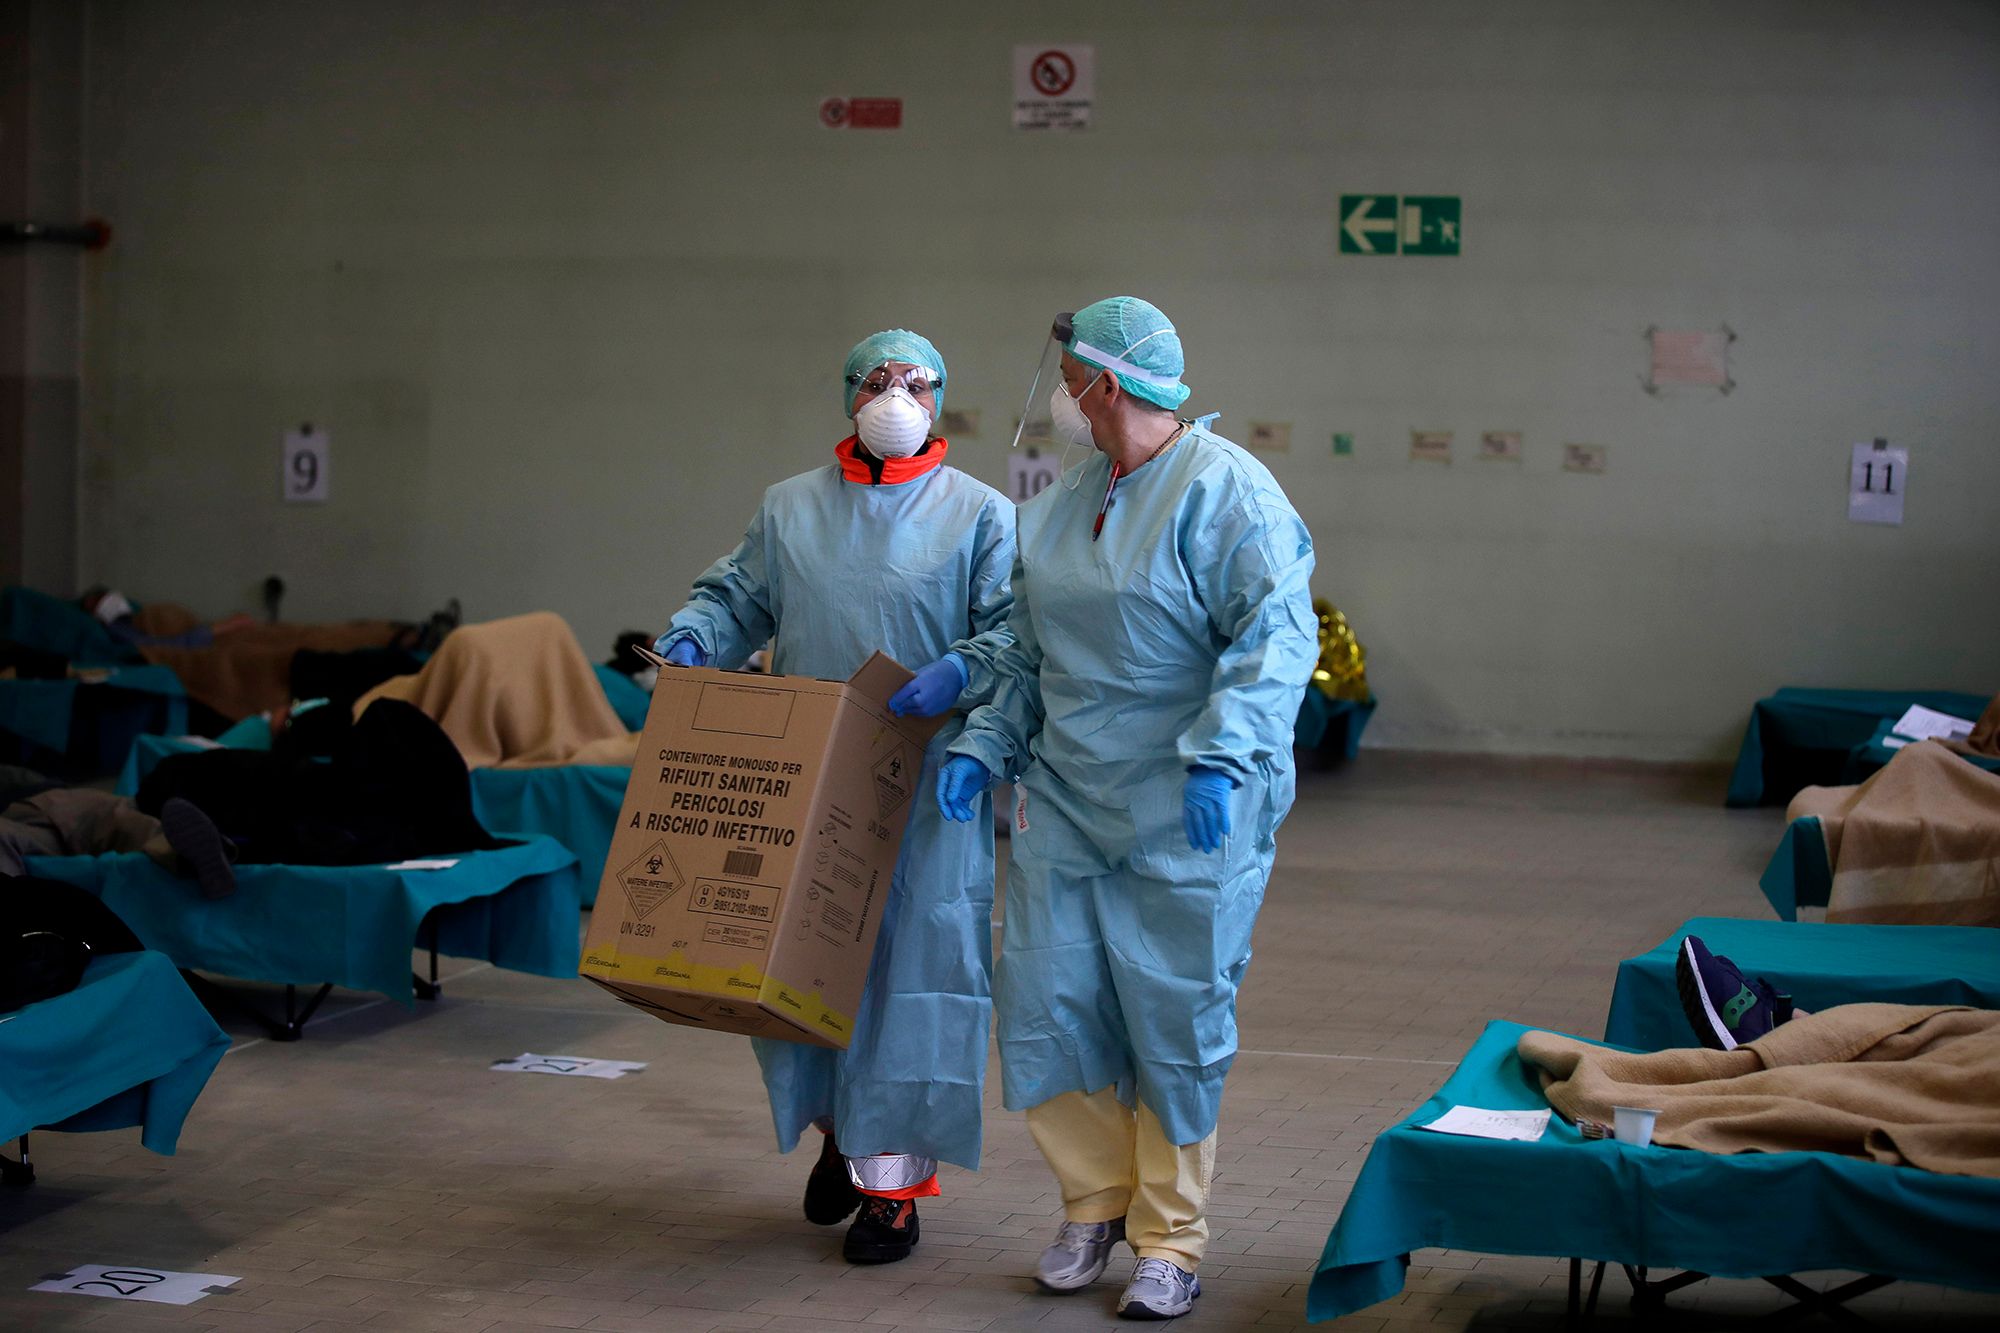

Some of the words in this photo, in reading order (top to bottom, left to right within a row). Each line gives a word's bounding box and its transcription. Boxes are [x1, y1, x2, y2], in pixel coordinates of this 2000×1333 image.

[293, 449, 318, 496] 9
[1017, 469, 1053, 500] 10
[1859, 461, 1896, 495] 11
[658, 749, 727, 767] CONTENITORE
[728, 756, 779, 773] MONOUSO
[781, 762, 802, 776] PER
[659, 767, 715, 788] RIFIUTI
[718, 773, 791, 798] SANITARI
[671, 792, 765, 819] PERICOLOSI
[629, 811, 641, 829] A
[646, 813, 709, 837] RISCHIO
[712, 820, 795, 847] INFETTIVO
[620, 921, 634, 935] UN
[635, 923, 656, 937] 3291
[71, 1270, 167, 1296] 20
